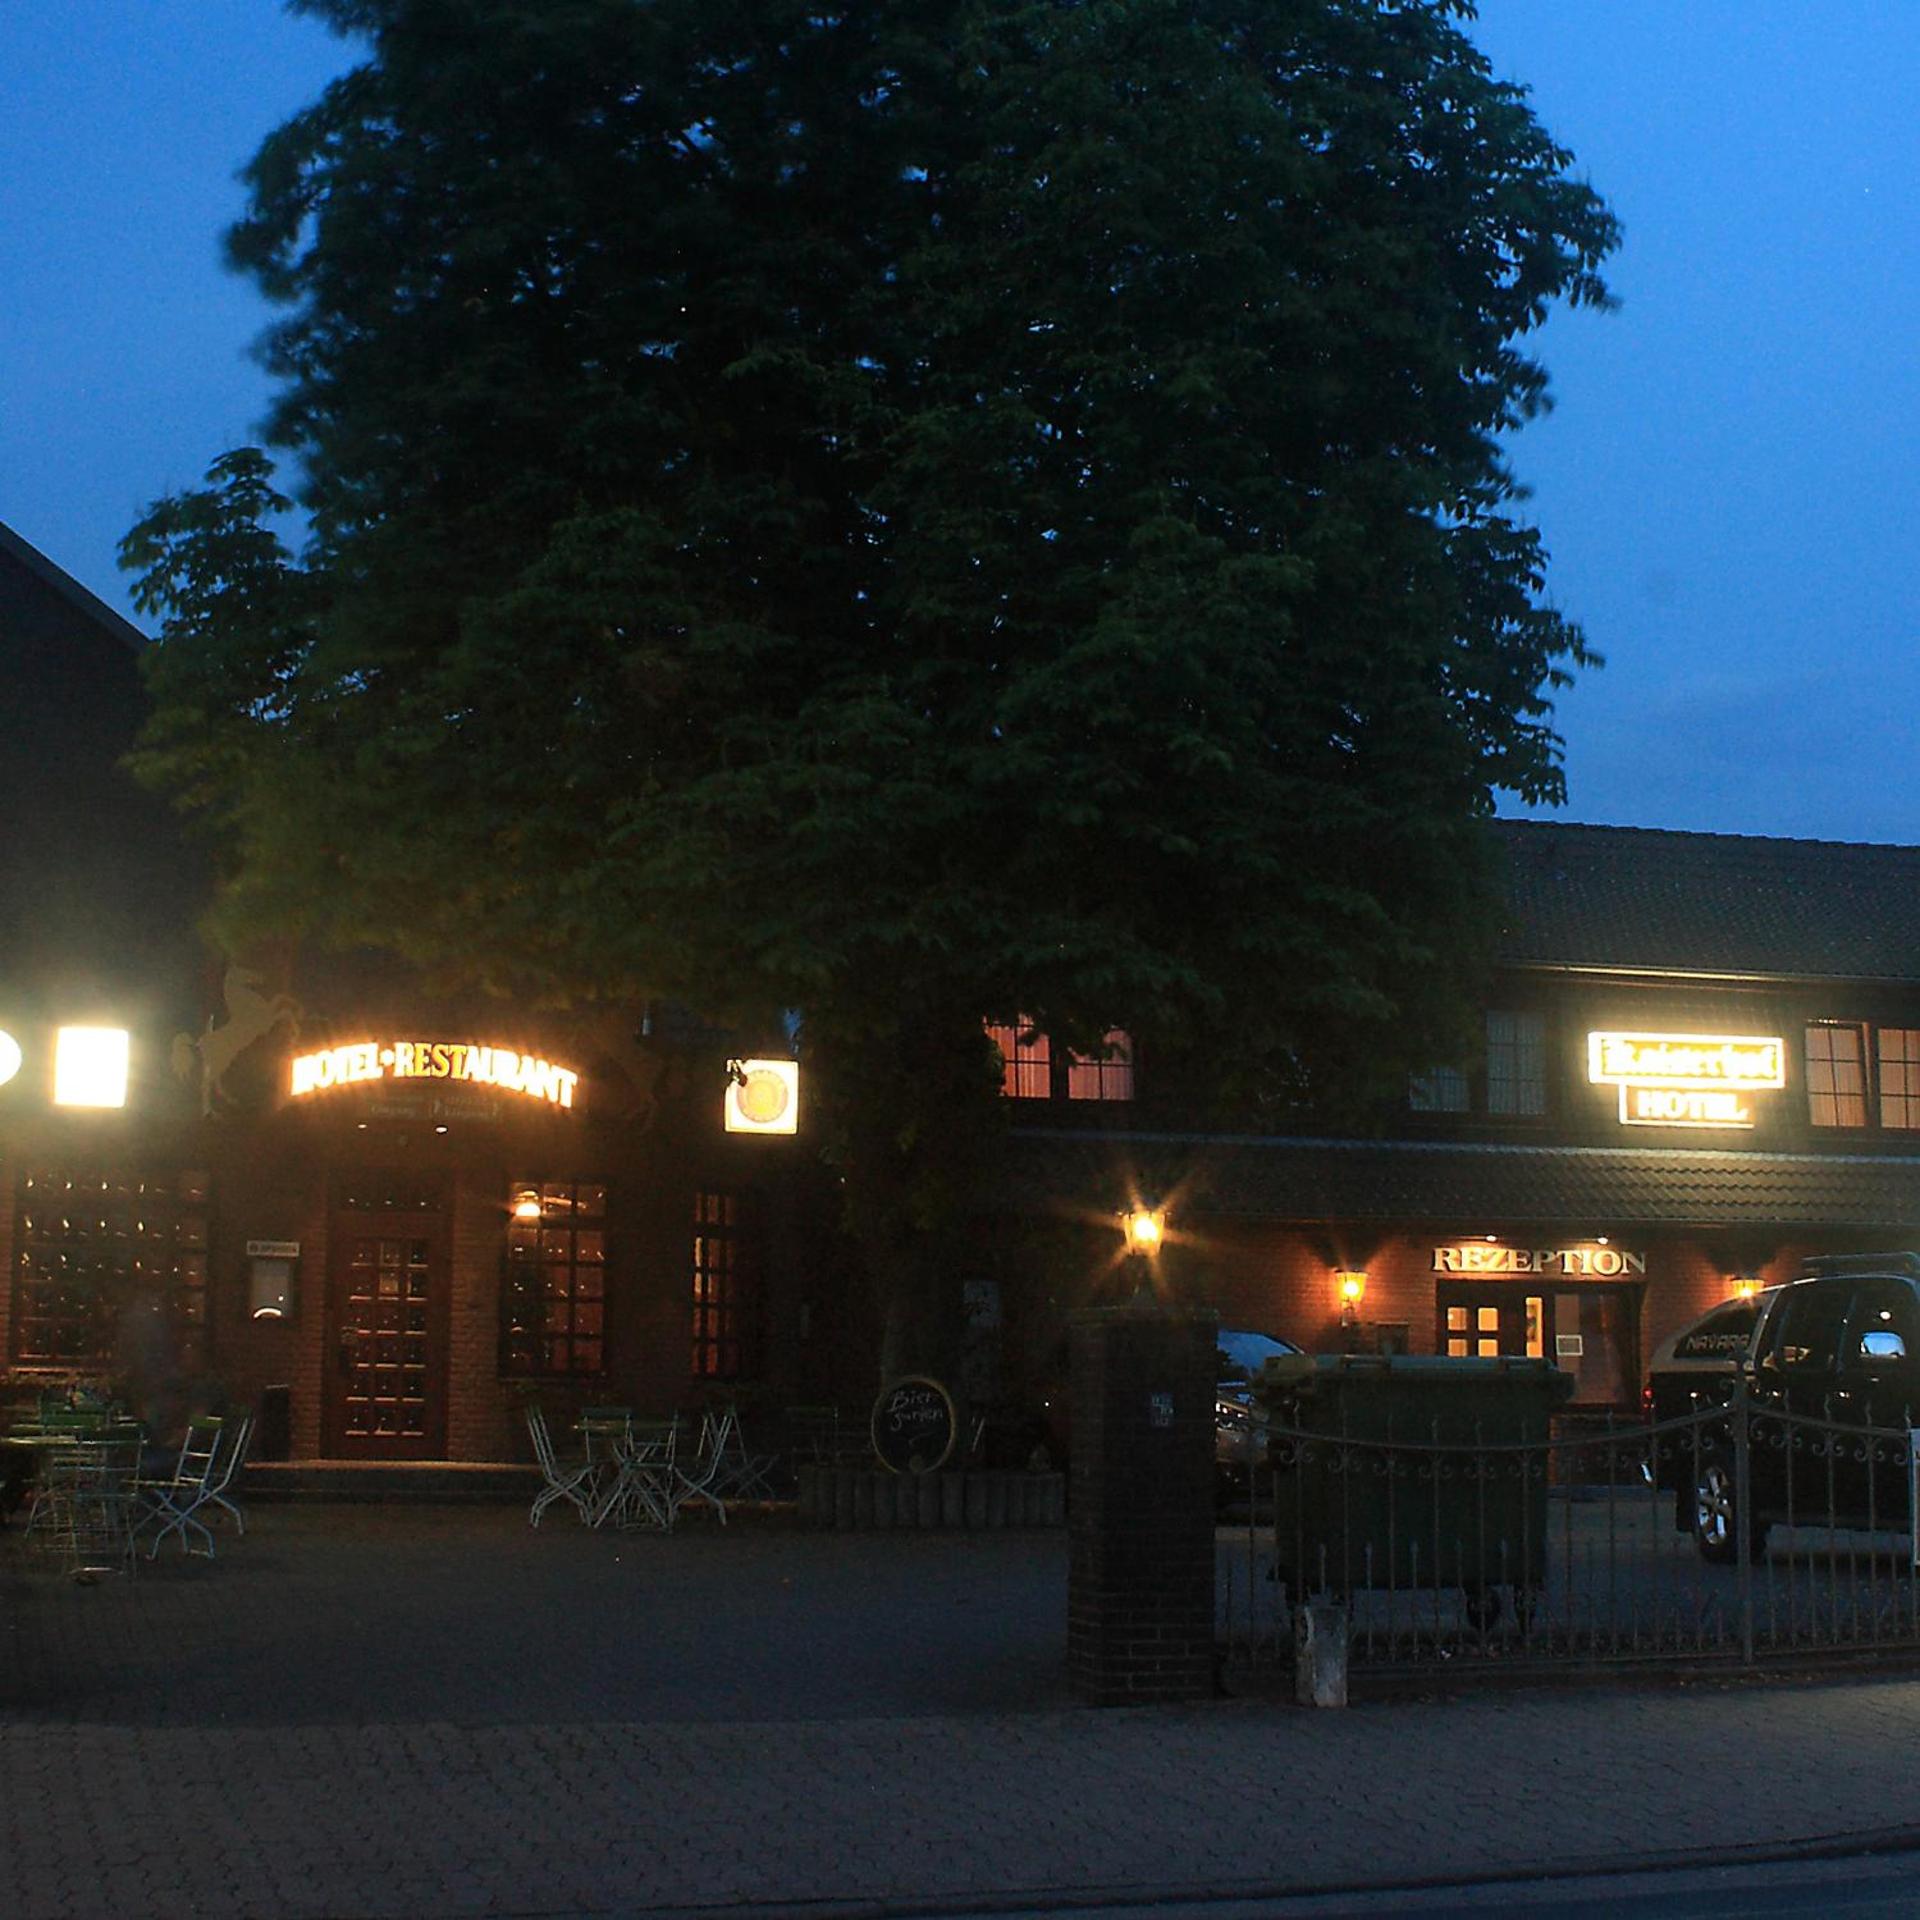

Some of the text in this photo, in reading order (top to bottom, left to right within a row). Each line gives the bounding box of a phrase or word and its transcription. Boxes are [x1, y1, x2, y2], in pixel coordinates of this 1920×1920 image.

[1638, 1091, 1746, 1120] HOTEL
[1432, 1247, 1646, 1275] REZEPTION
[1686, 1334, 1751, 1351] NAVARA
